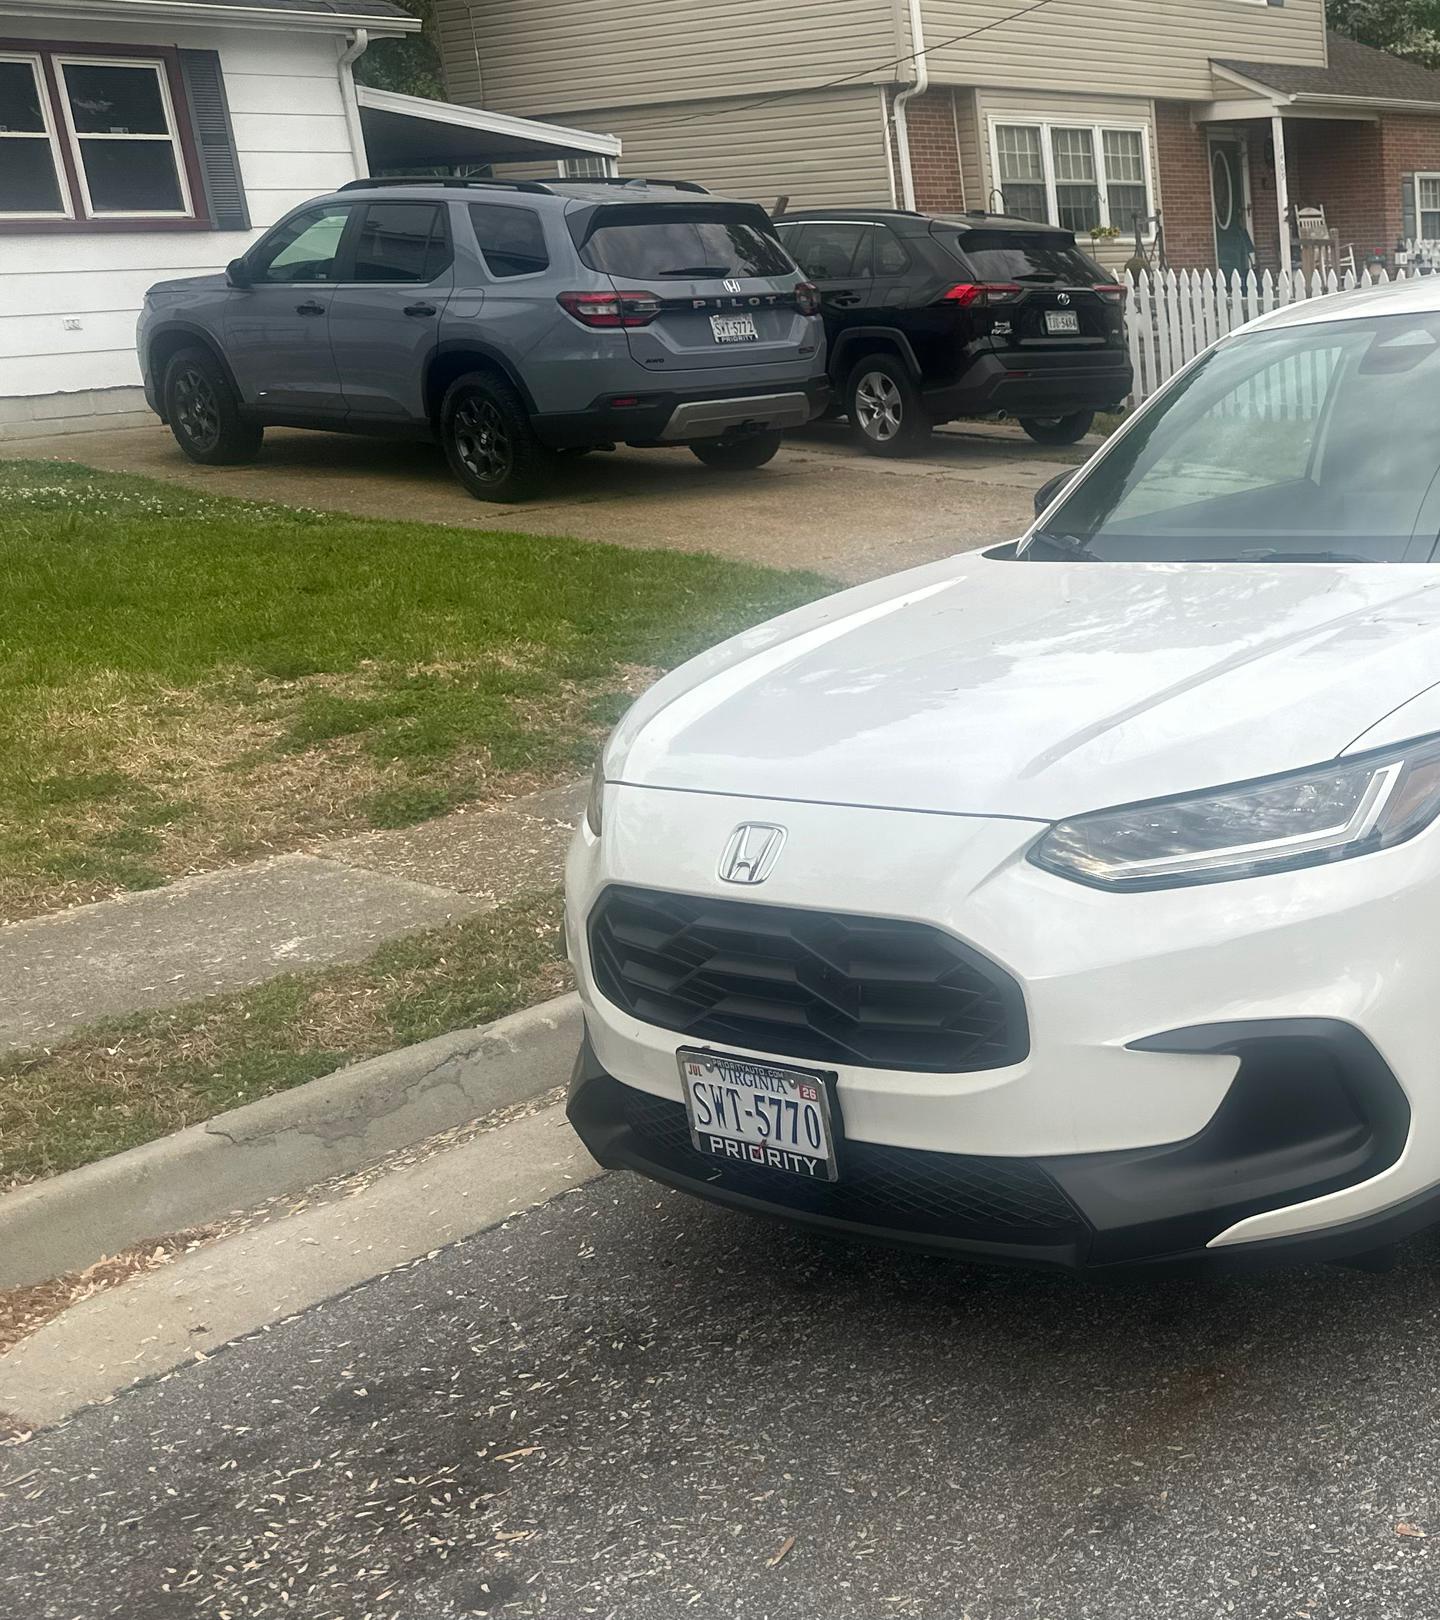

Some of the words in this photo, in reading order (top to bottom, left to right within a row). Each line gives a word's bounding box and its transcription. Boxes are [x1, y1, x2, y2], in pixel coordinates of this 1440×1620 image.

[692, 296, 777, 309] PILOT
[714, 320, 754, 336] SWT-5772
[721, 335, 753, 343] PRIORITY
[688, 1063, 703, 1077] JUL
[712, 1059, 784, 1079] PRIORITYAUTO.COM
[717, 1065, 788, 1095] VIRGINIA
[802, 1086, 817, 1100] 26
[692, 1081, 822, 1149] SWT-5770
[710, 1135, 818, 1176] PRIORITY
